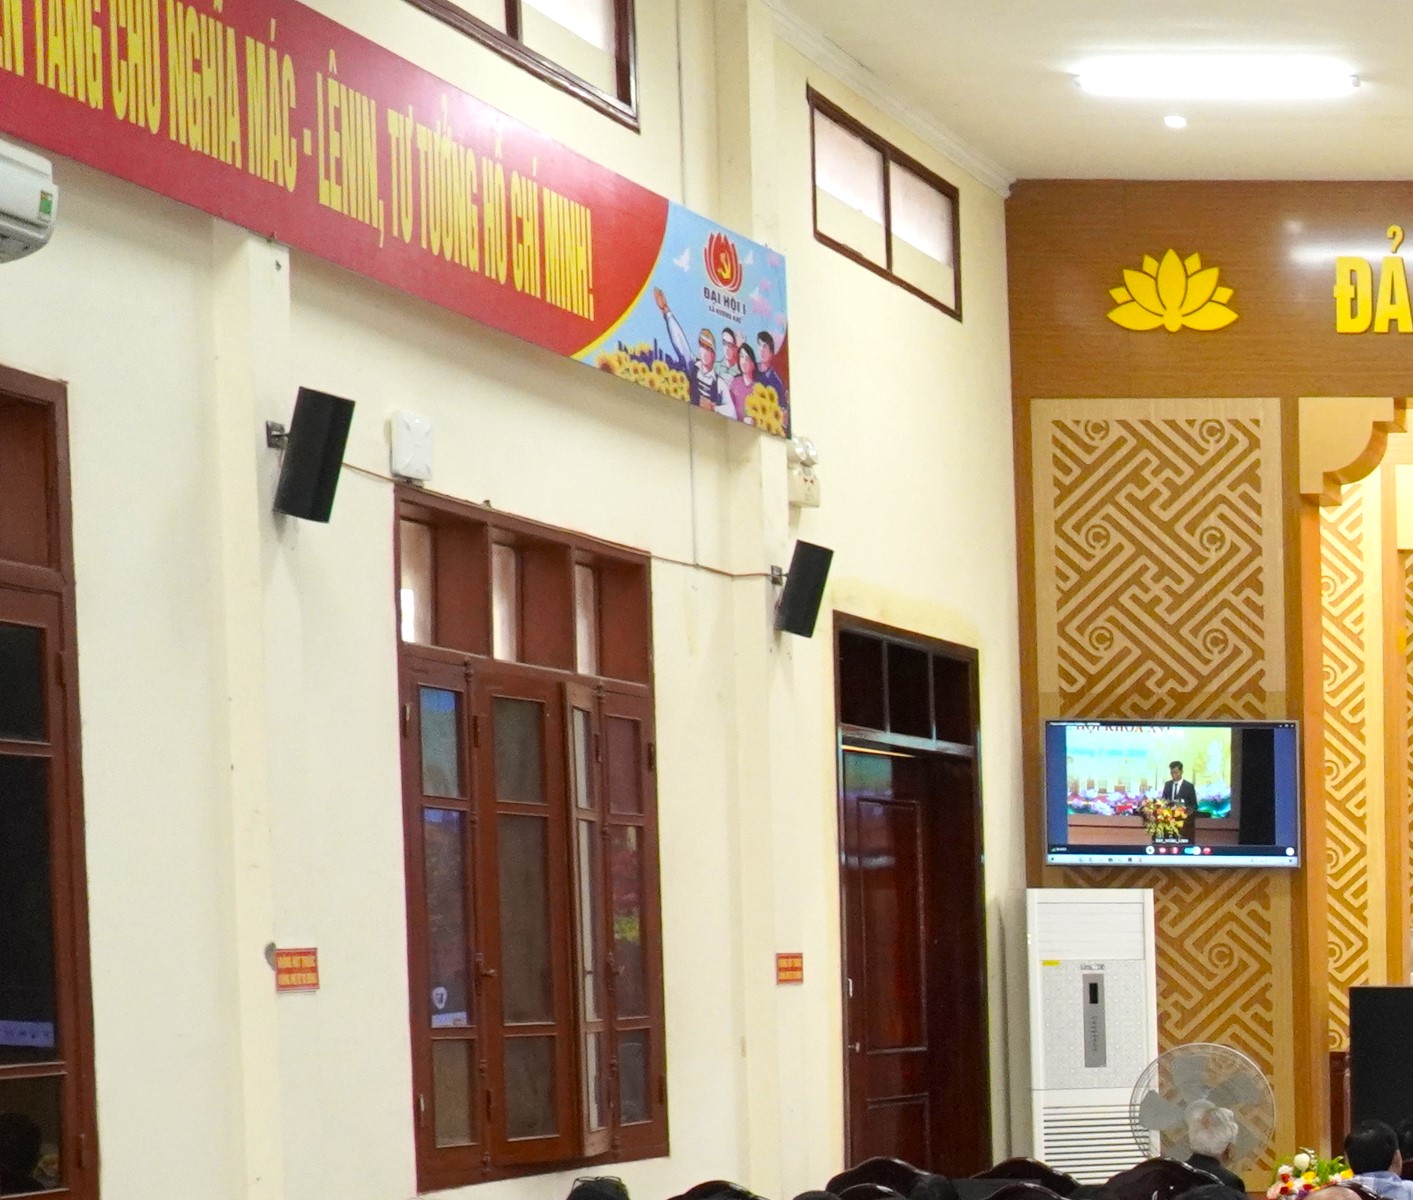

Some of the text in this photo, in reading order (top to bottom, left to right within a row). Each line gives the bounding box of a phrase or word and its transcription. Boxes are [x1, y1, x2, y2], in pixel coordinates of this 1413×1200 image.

[166, 0, 242, 170] NGHĨA
[245, 17, 297, 193] MÁC
[316, 49, 384, 248] LÊNIN,
[416, 93, 479, 273] TƯỞNG
[482, 132, 507, 285] HỒ
[511, 156, 541, 300] CHÍ
[543, 187, 594, 321] MINH!
